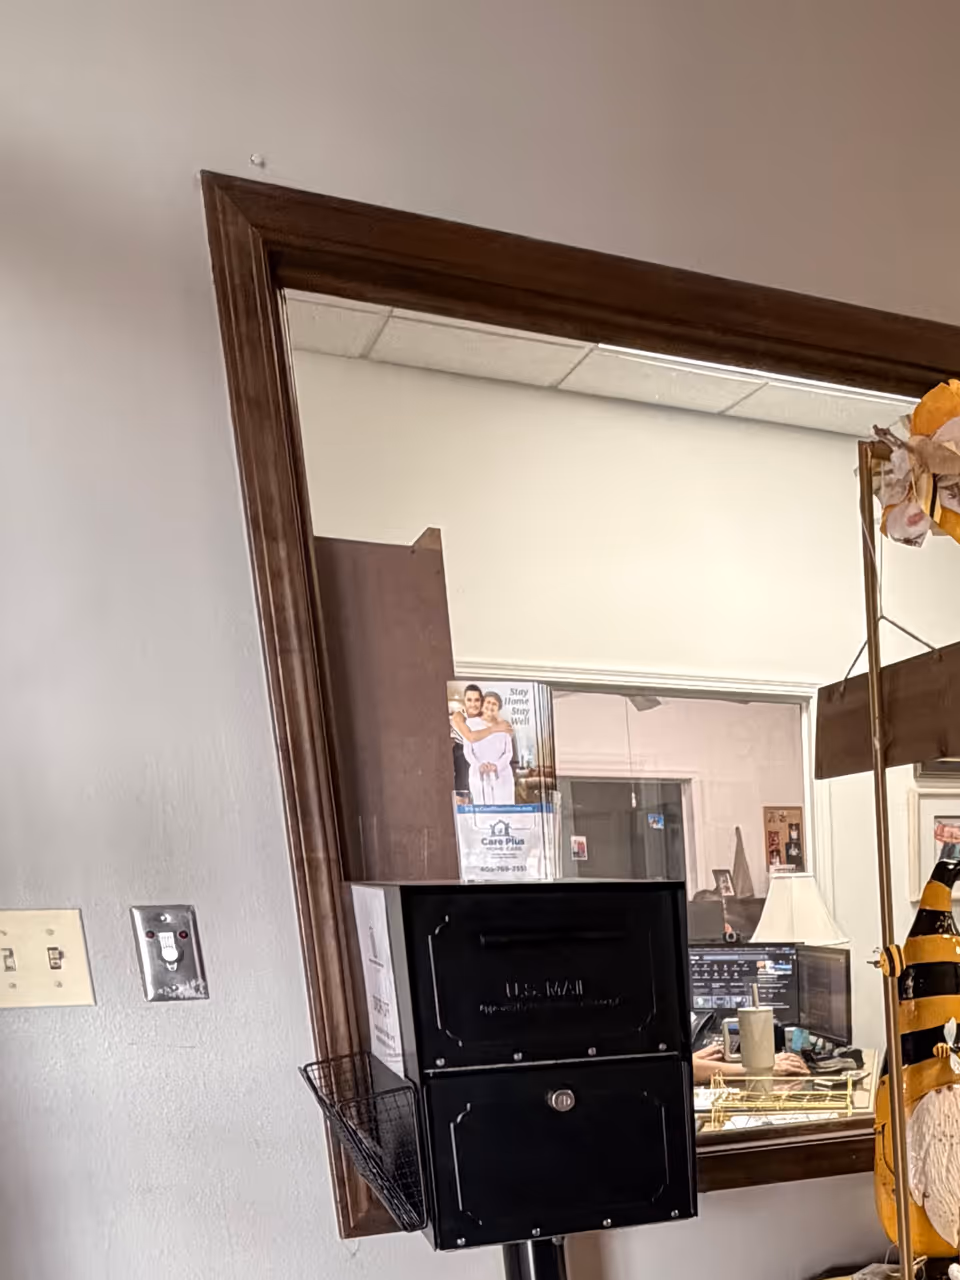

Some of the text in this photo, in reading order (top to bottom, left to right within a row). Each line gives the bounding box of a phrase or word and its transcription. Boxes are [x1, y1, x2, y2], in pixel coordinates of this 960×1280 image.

[509, 688, 529, 698] Stay
[504, 697, 529, 706] Home
[511, 706, 530, 717] Stay
[511, 716, 530, 727] Well
[481, 837, 525, 846] Care Plus
